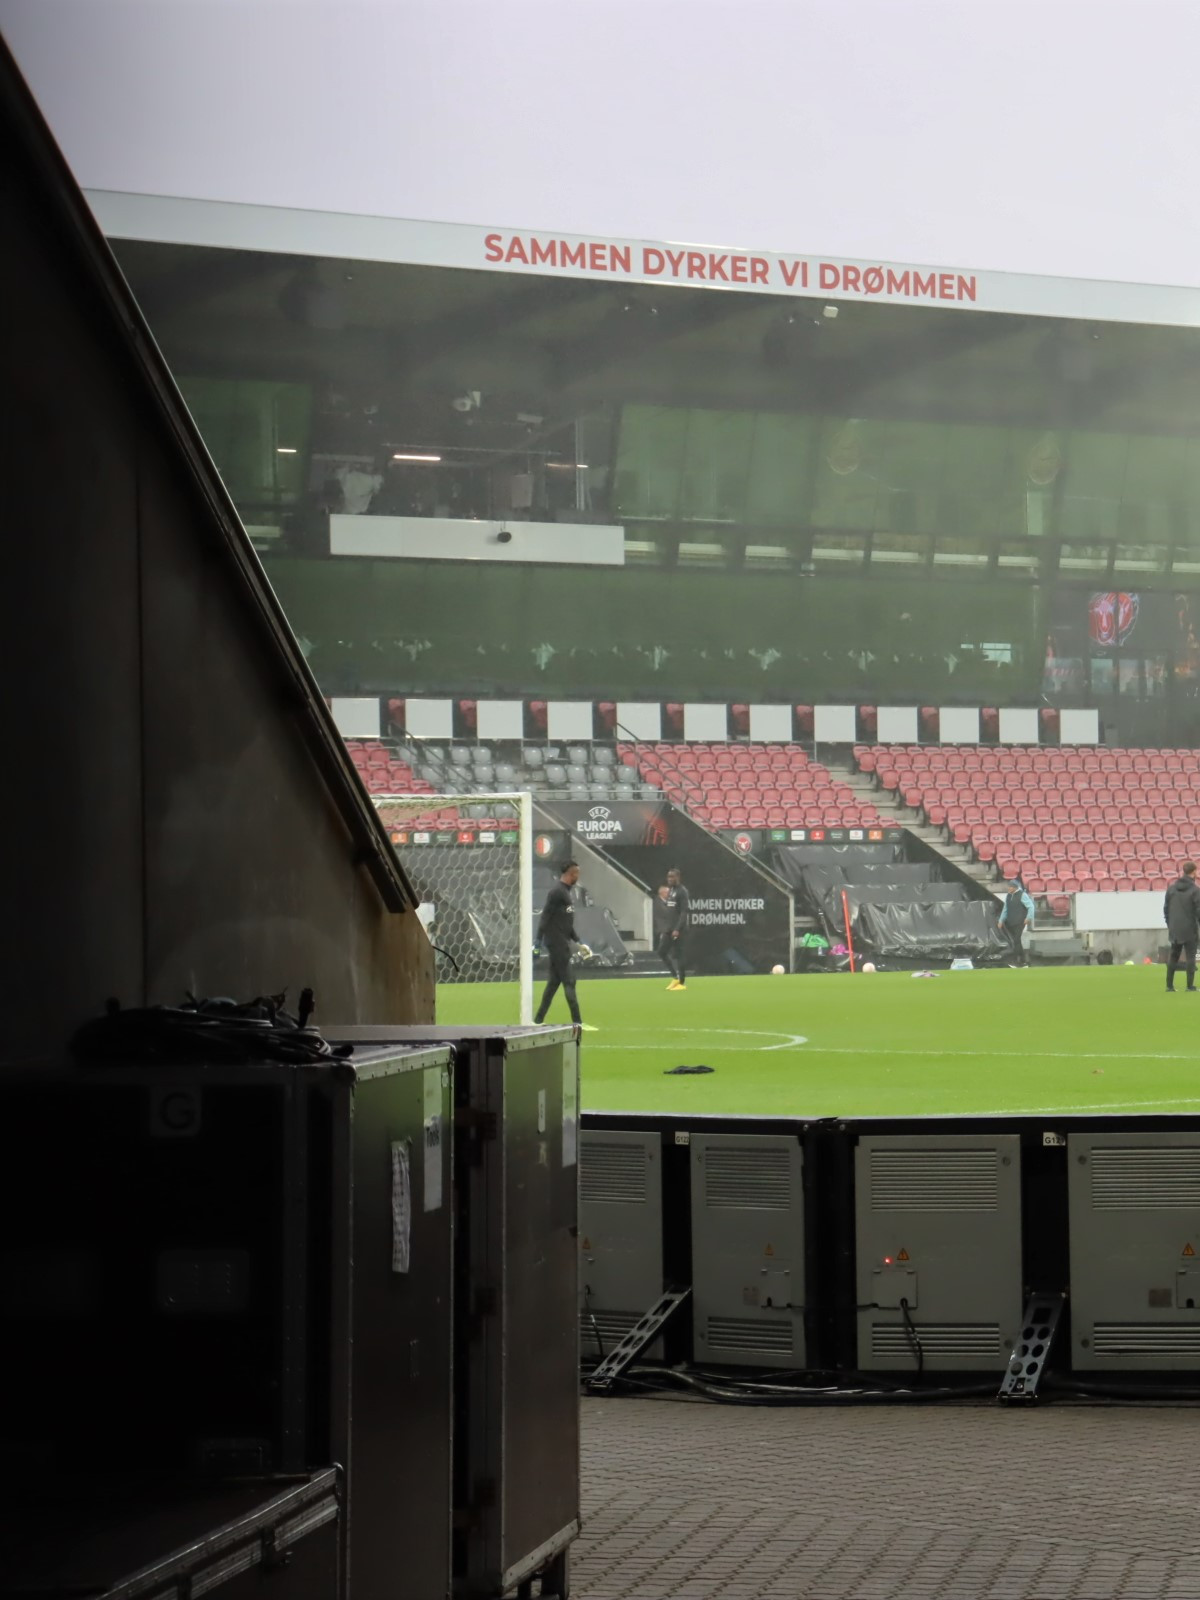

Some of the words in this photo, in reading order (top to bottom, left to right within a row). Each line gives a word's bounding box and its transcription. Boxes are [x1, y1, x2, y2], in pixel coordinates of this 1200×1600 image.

[484, 234, 631, 273] SAMMEN
[643, 248, 769, 284] DYRKER
[778, 259, 808, 288] VI
[819, 263, 976, 301] DRØMMEN
[577, 820, 622, 832] EUROPA
[688, 899, 721, 910] AMMEN
[724, 899, 764, 910] DYRKER
[692, 913, 746, 925] DRØMMEN.
[160, 1091, 195, 1130] G
